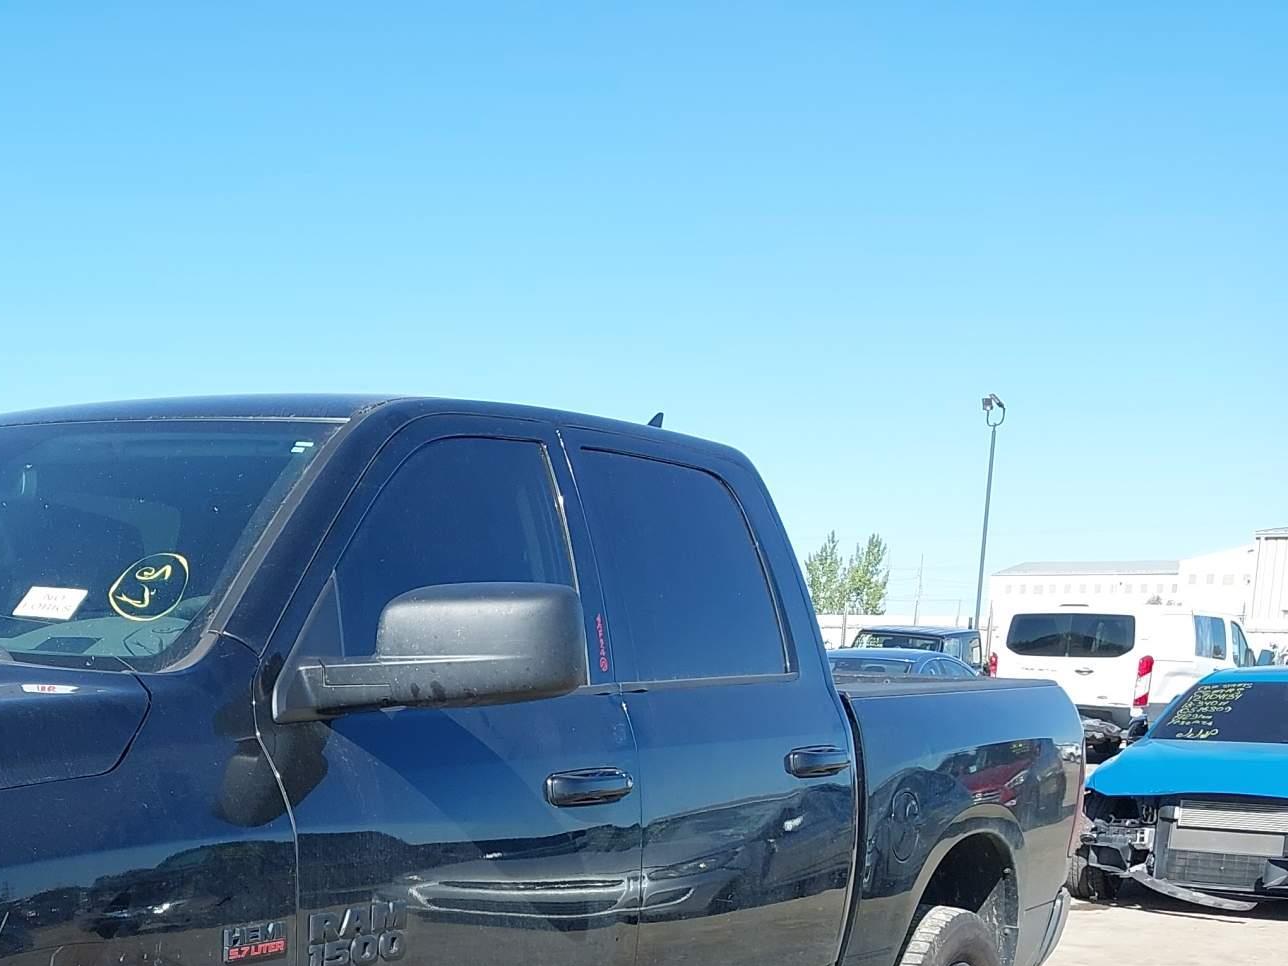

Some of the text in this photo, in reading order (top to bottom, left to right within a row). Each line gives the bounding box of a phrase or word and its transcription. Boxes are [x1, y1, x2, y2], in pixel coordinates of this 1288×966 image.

[308, 899, 408, 942] RAM
[223, 921, 286, 947] HEMI
[228, 940, 285, 960] 5.7 LITER
